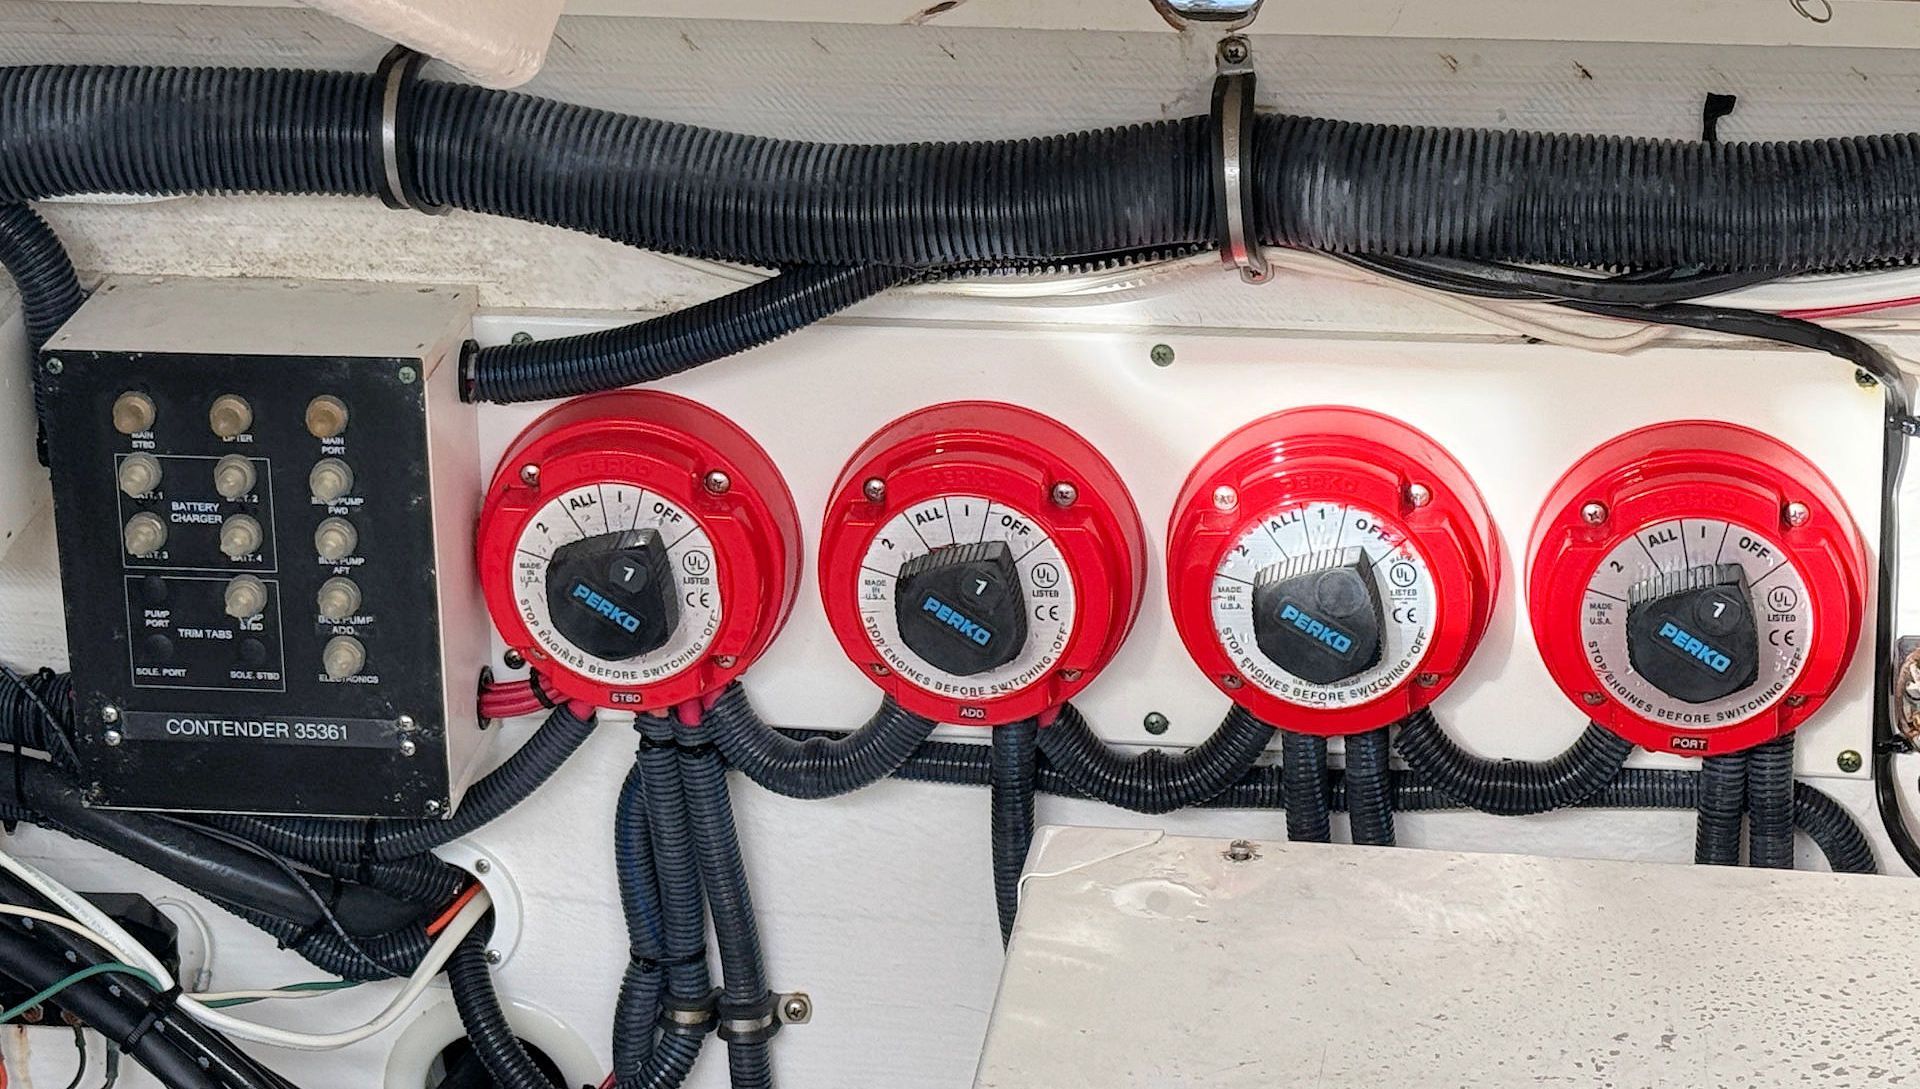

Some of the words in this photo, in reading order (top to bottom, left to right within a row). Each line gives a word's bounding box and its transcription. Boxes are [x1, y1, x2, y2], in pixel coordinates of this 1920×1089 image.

[321, 436, 344, 445] MAIN
[321, 446, 346, 455] PORT
[171, 501, 220, 513] BATTERY
[570, 493, 597, 510] ALL
[327, 506, 349, 515] FWD
[653, 501, 683, 525] OFF
[915, 507, 944, 526] ALL
[170, 513, 223, 525] CHARGER
[1269, 509, 1301, 534] ALL
[536, 522, 549, 534] 2
[1000, 514, 1031, 537] OFF
[1355, 518, 1394, 546] OFF
[1648, 528, 1678, 548] ALL
[882, 538, 895, 551] 2
[1237, 544, 1250, 557] 2
[1738, 536, 1770, 560] OFF
[333, 566, 351, 575] AFT
[519, 562, 541, 570] MADE
[1610, 561, 1625, 573] 2
[683, 577, 710, 585] LISTED
[864, 579, 887, 587] MADE
[1032, 590, 1060, 598] LISTED
[1217, 586, 1242, 594] MADE
[1389, 588, 1418, 597] LISTED
[572, 583, 641, 634] PERKO
[1589, 603, 1613, 611] MADE
[144, 609, 170, 619] PUMP
[1767, 614, 1797, 622] LISTED
[145, 619, 169, 628] PORT
[923, 596, 992, 646] PERKO
[178, 628, 204, 639] TRIM
[205, 629, 233, 640] TABS
[1280, 603, 1353, 655] PERKO
[520, 598, 539, 634] STOP
[538, 629, 585, 669] ENGINES
[588, 664, 640, 680] BEFORE
[642, 641, 702, 679] SWITCHING
[1660, 621, 1732, 674] PERKO
[1222, 626, 1244, 658] STOP
[1240, 656, 1290, 694] ENGINES
[1292, 688, 1346, 701] BEFORE
[1350, 658, 1411, 698] SWITCHING
[162, 668, 187, 678] PORT
[882, 647, 931, 686] ENGINES
[935, 681, 985, 696] BEFORE
[991, 655, 1052, 695] SWITCHING
[611, 694, 641, 703] STBD
[1603, 666, 1653, 713] ENGINES
[1657, 709, 1711, 724] BEFORE
[1716, 682, 1784, 722] SWITCHING
[166, 718, 290, 739] CONTENDER
[294, 723, 348, 741] 35361
[1672, 738, 1707, 750] PORT
